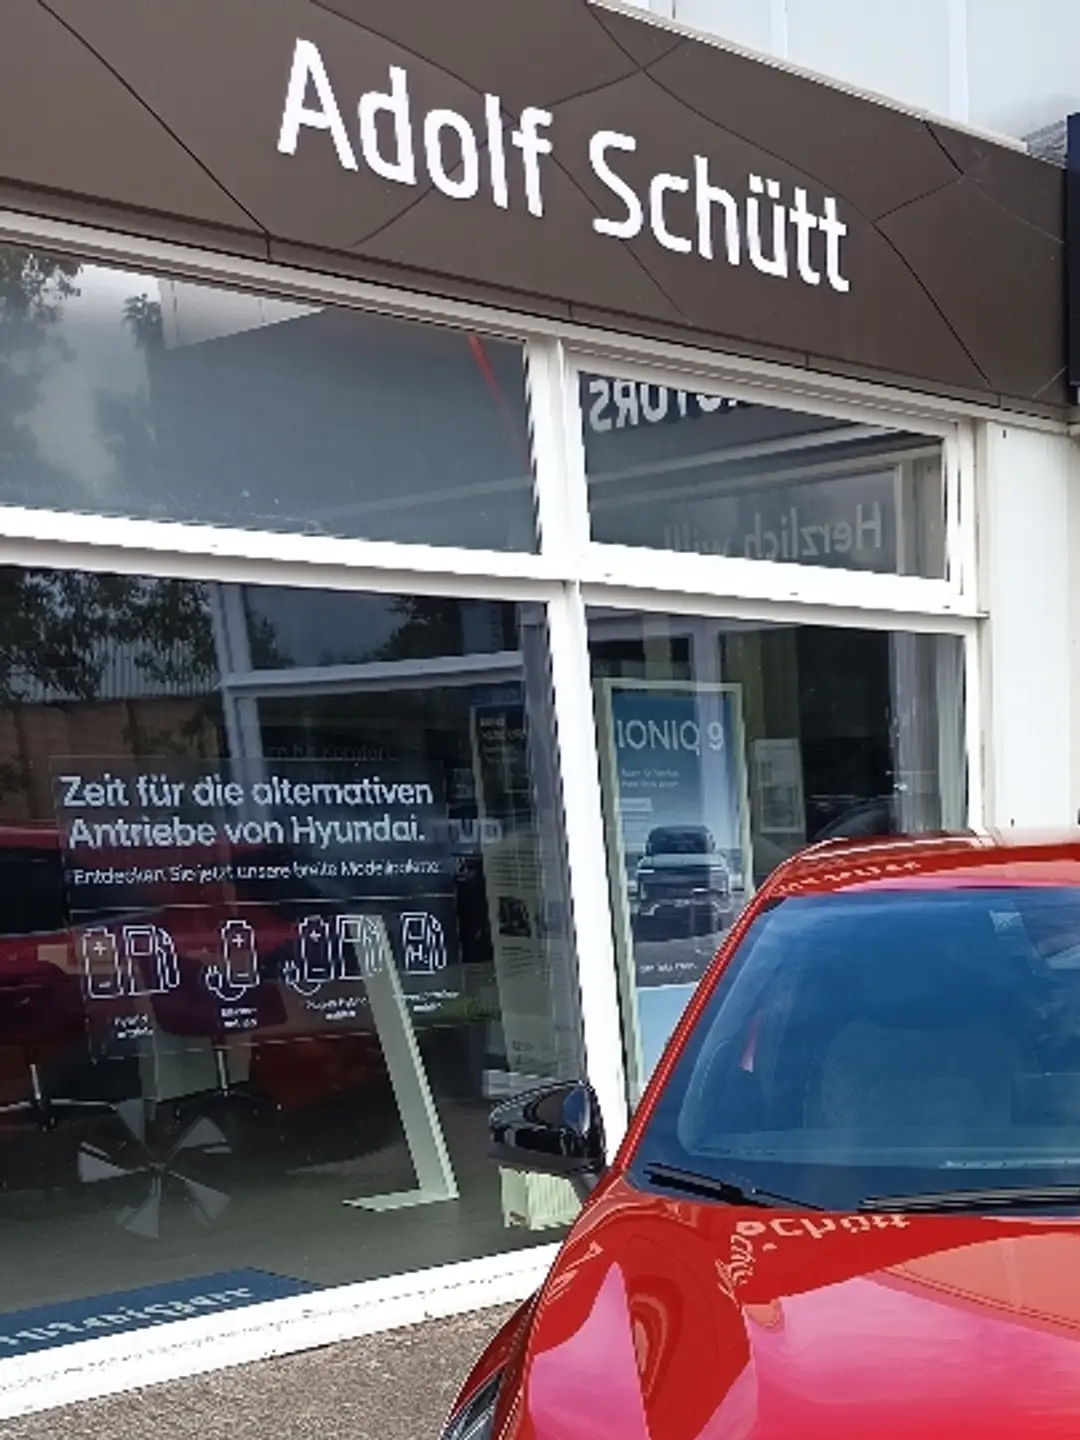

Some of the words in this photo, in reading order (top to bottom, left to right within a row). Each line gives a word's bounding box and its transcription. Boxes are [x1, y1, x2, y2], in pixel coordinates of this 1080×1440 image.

[277, 38, 553, 218] Adolf
[589, 130, 850, 293] Schütt
[617, 719, 700, 756] IONIQ
[707, 721, 724, 751] 9
[59, 772, 130, 808] Zeit
[136, 773, 185, 808] für
[192, 773, 245, 808] die
[252, 775, 434, 806] alternativen
[69, 815, 217, 850] Antriebe
[224, 821, 285, 846] von
[290, 813, 426, 850] Hyundai.
